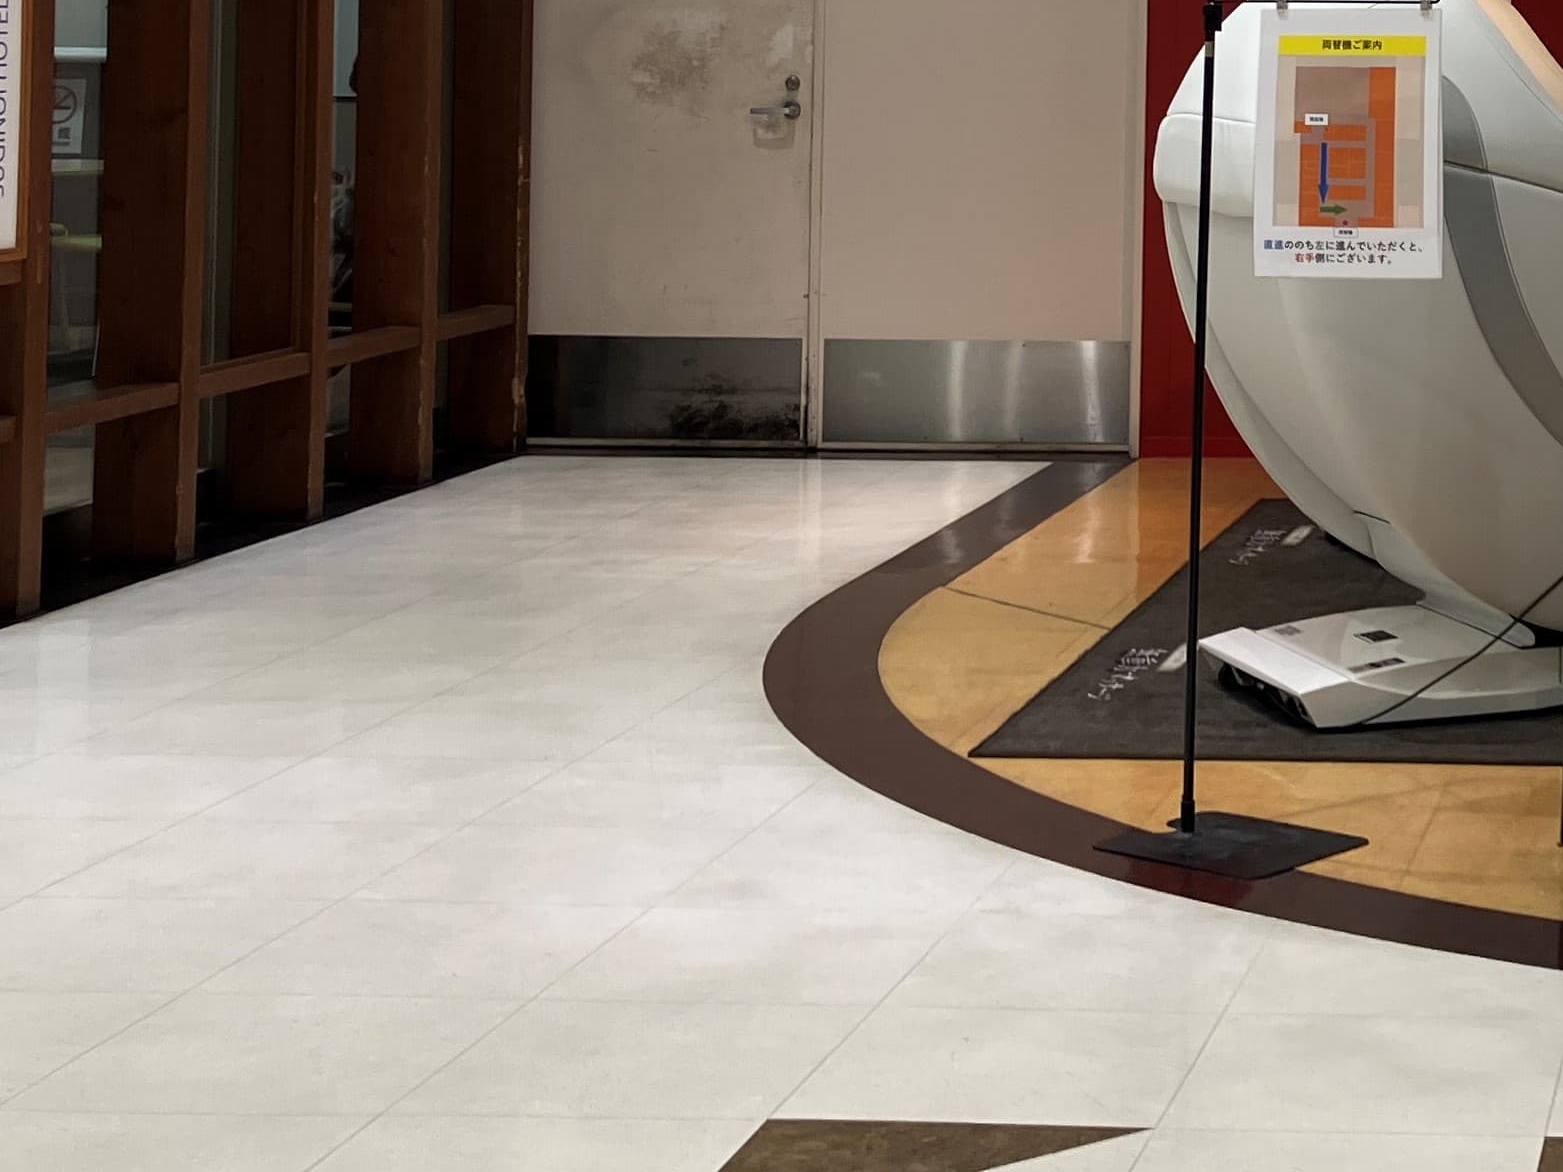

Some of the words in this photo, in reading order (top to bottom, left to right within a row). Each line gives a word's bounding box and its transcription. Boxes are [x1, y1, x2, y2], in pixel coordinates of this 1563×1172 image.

[1322, 39, 1382, 51] 両替機ご案内
